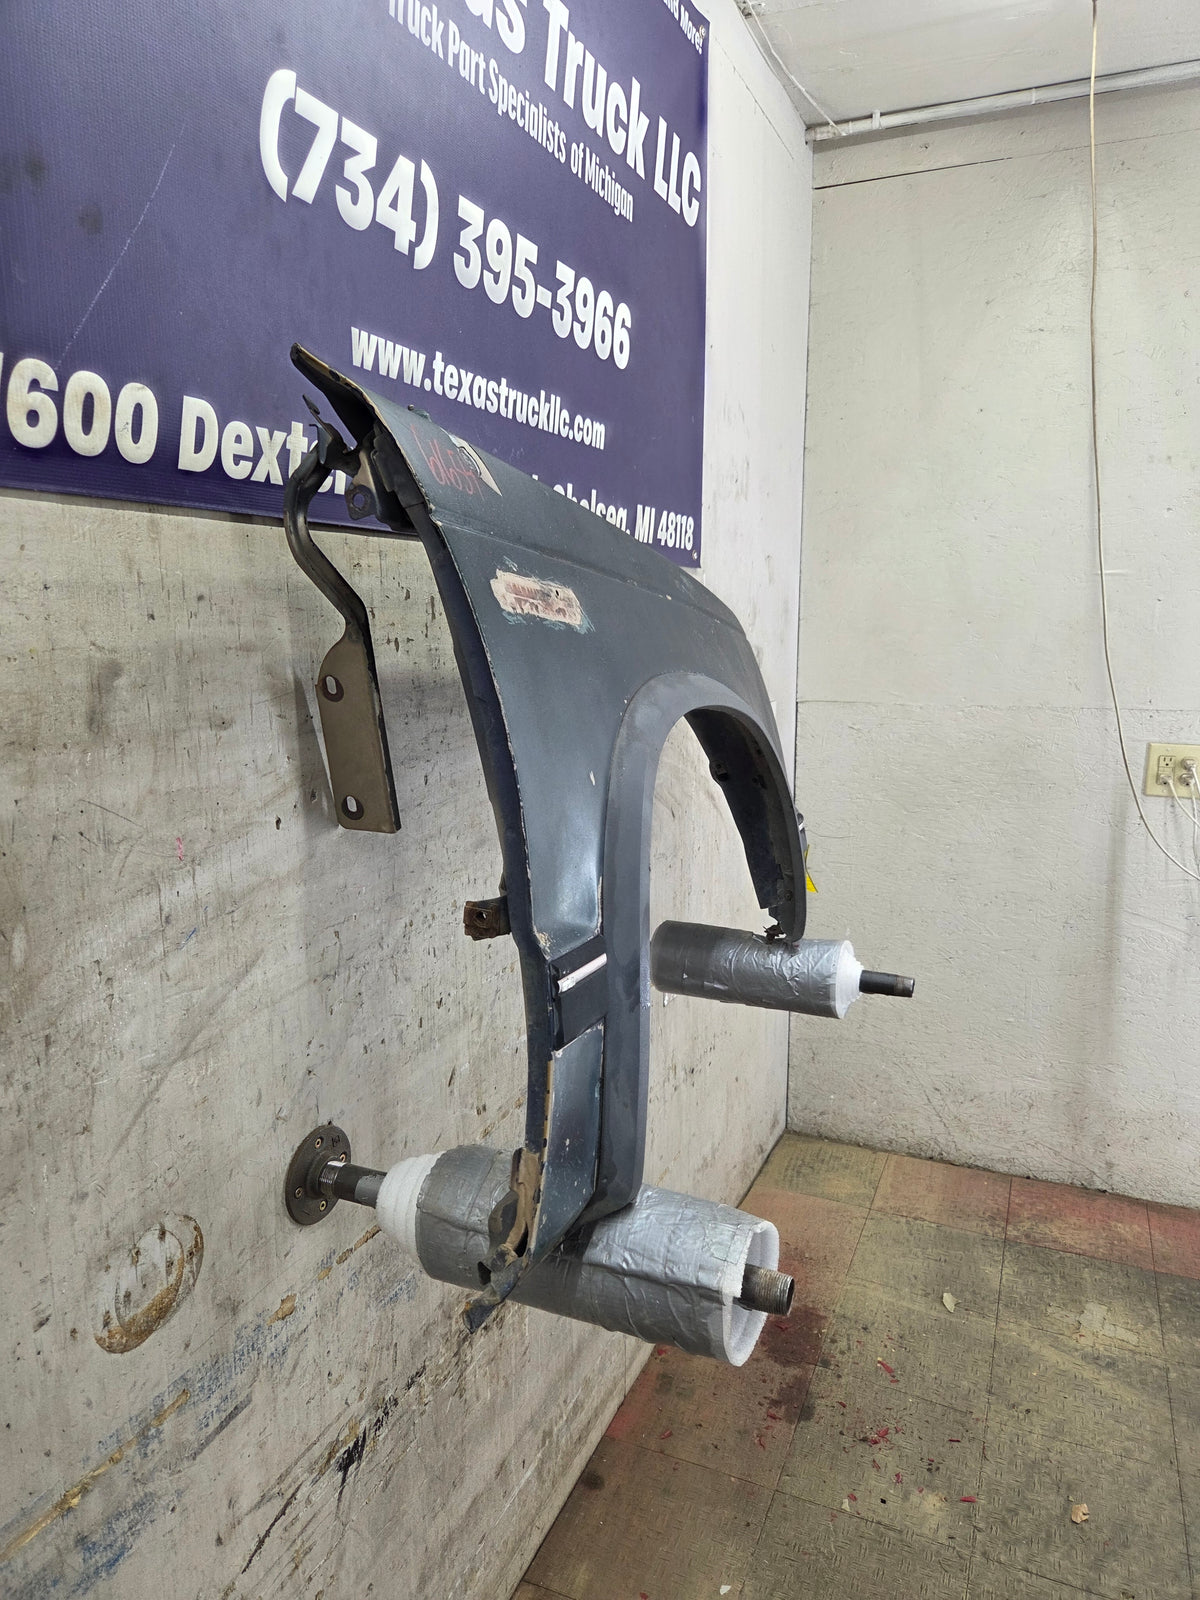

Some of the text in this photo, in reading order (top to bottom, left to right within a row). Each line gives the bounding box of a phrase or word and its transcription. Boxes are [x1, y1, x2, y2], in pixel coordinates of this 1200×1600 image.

[447, 18, 487, 95] Part
[488, 57, 567, 164] Specialists
[570, 141, 585, 179] of
[584, 146, 634, 223] Michigan
[543, 0, 650, 180] Truck
[653, 115, 702, 227] LLC
[680, 4, 704, 55] More!
[259, 68, 632, 370] (734) 395-3966
[0, 351, 159, 465] 600
[634, 503, 656, 544] MI
[656, 510, 695, 551] 48118
[350, 326, 606, 451] www.texastruckllc.com
